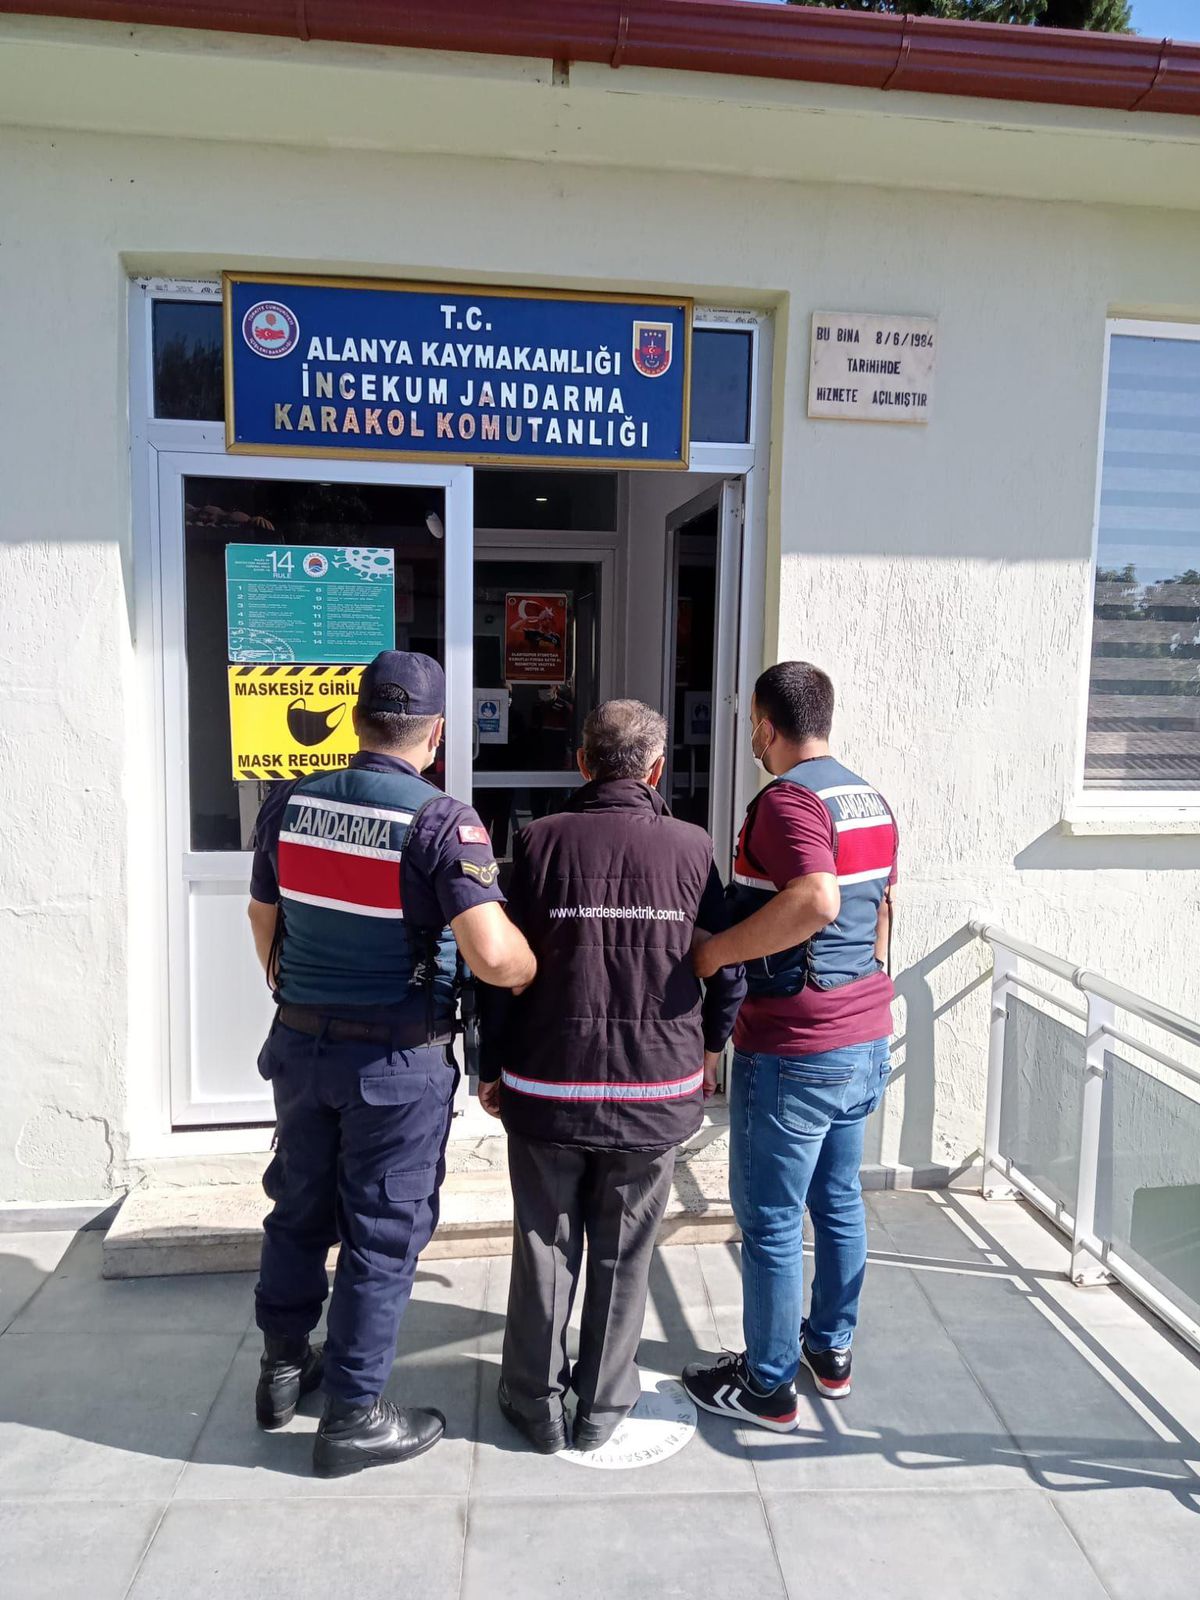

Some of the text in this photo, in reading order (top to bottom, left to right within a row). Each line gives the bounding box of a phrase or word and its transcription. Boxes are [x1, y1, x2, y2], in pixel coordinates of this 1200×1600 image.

[440, 304, 493, 332] T.C.
[816, 326, 830, 341] BU
[306, 336, 621, 376] ALANYA KAYMAKAMLIĞI
[301, 363, 625, 415] İNCEKUM JANDARMA
[273, 402, 649, 449] KARAKOL KOMUTANLIĞI
[266, 550, 295, 573] 14
[235, 680, 314, 696] MASKESİZ
[238, 754, 283, 767] MASK
[290, 806, 391, 849] JANDARMA
[549, 904, 686, 922] www.kardeselektrik.com.tr
